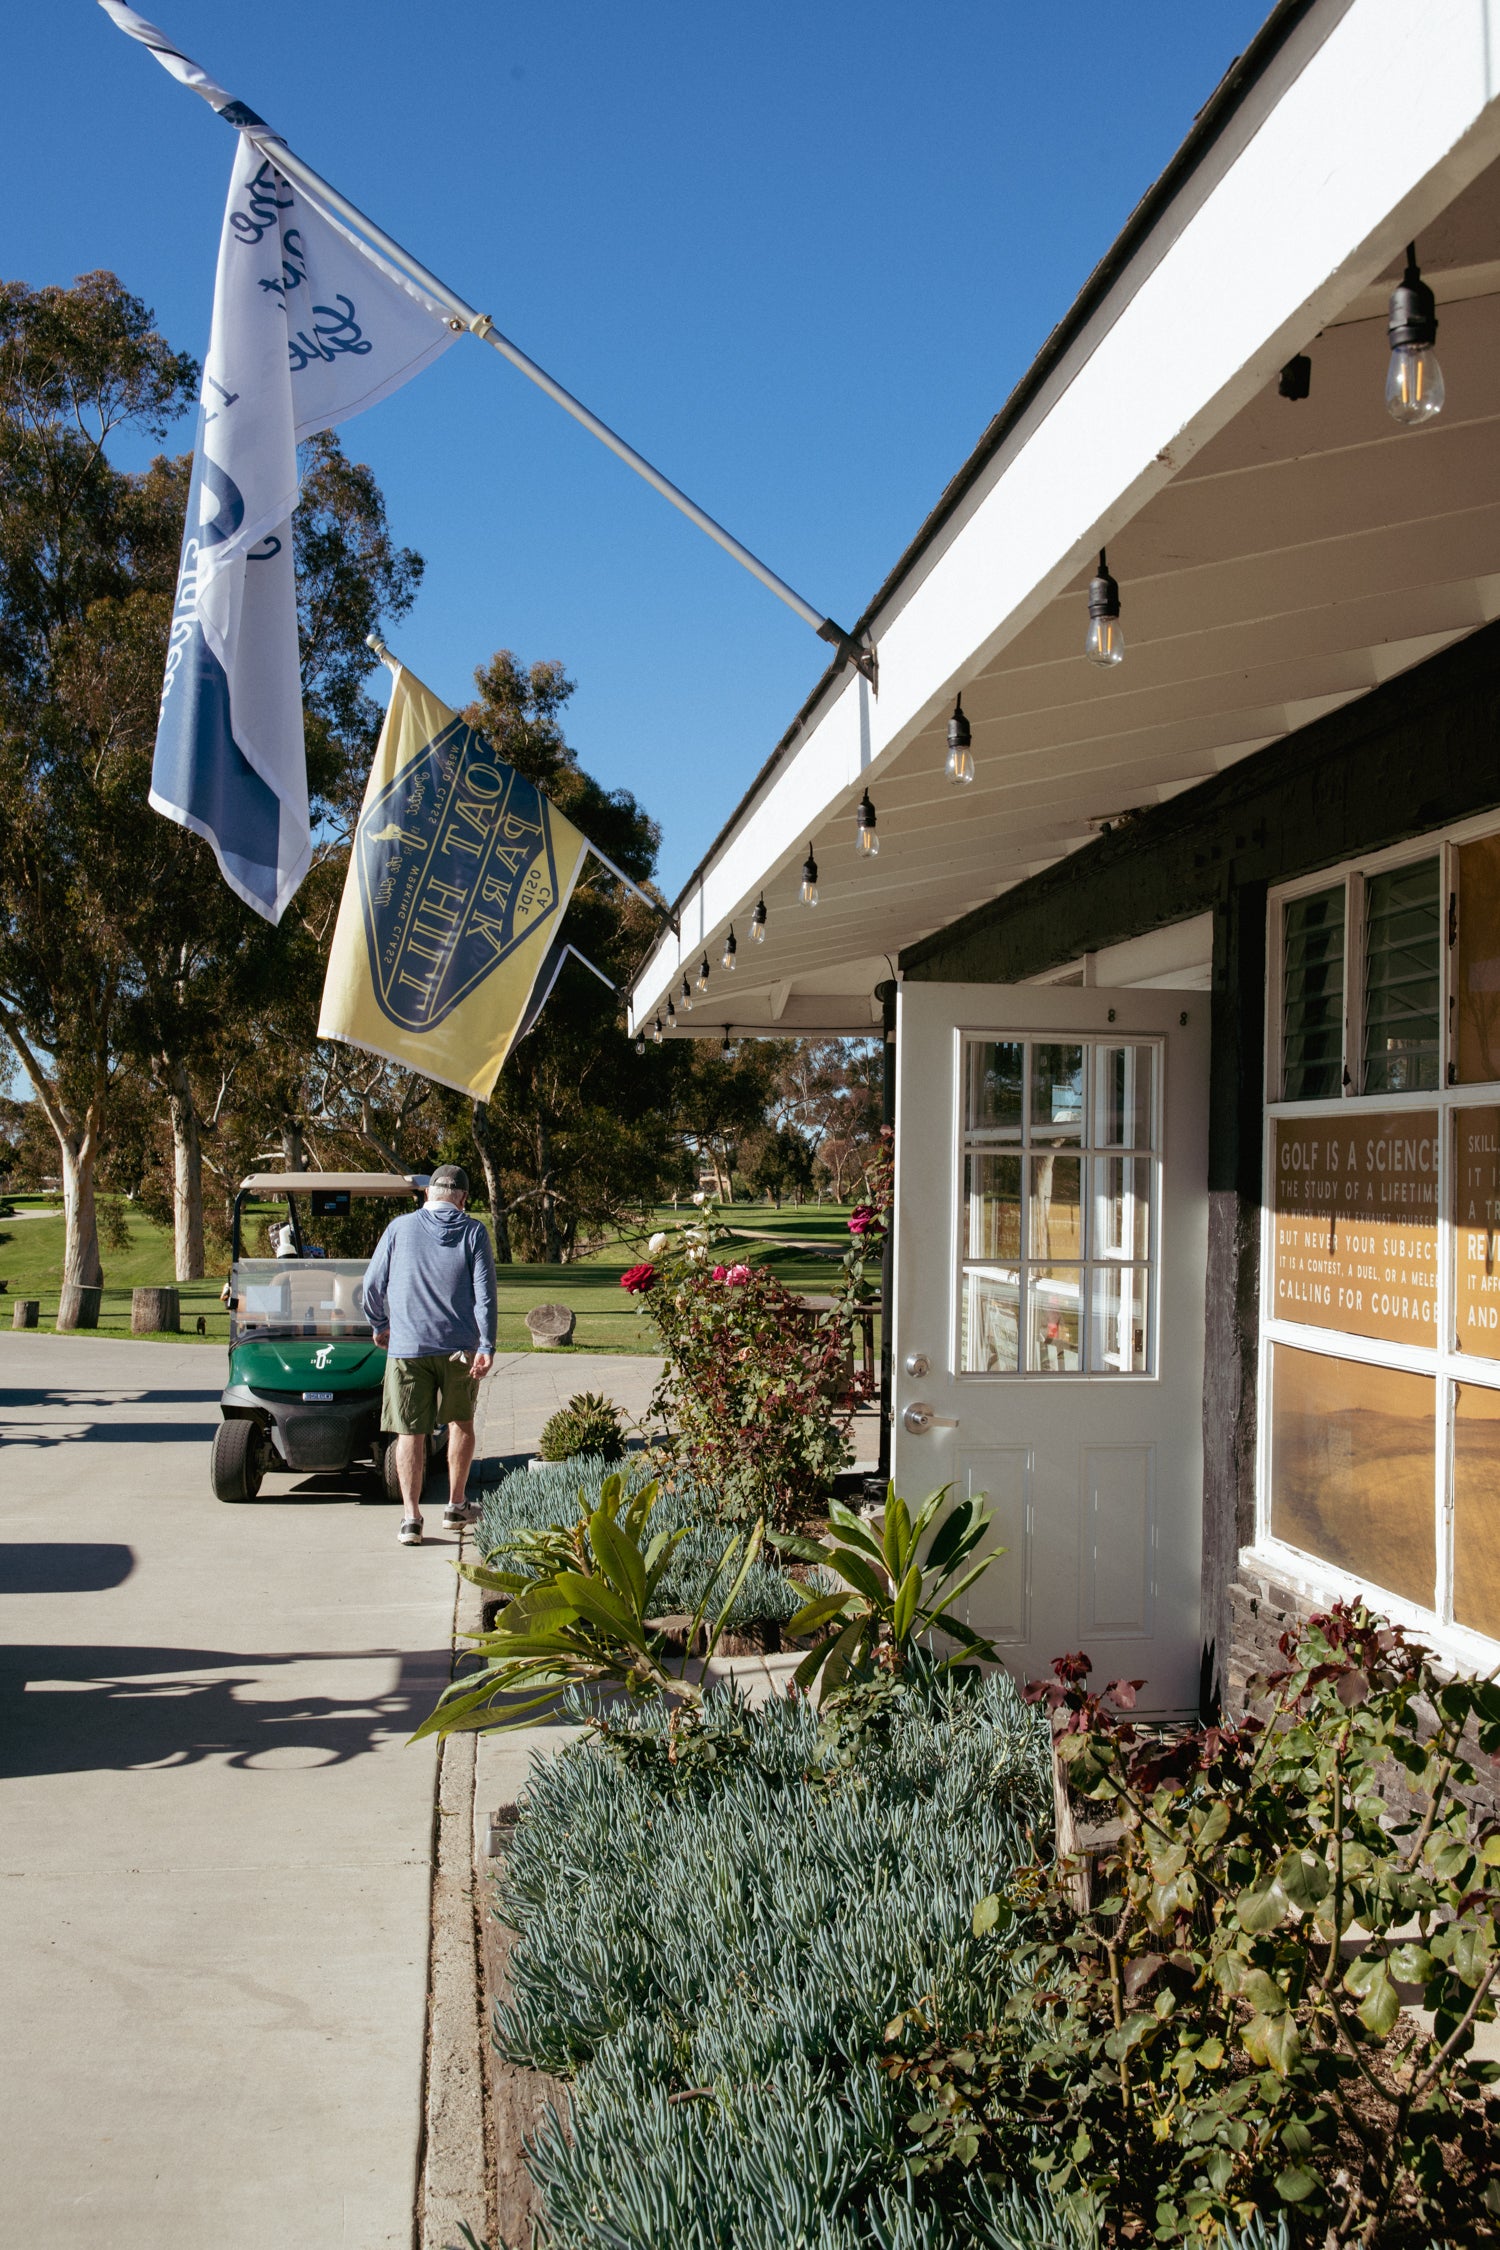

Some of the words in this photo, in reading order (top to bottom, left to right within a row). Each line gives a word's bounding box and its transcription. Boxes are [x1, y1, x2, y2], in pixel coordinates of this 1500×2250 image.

[1281, 1142, 1319, 1171] GOLF
[1326, 1140, 1339, 1171] IS
[1347, 1141, 1357, 1171] A
[1366, 1138, 1438, 1172] SCIENCE
[1468, 1167, 1481, 1187] IT
[1493, 1167, 1500, 1187] I
[1281, 1180, 1298, 1197] THE
[1304, 1180, 1338, 1199] STUDY
[1345, 1182, 1359, 1200] OF
[1367, 1183, 1374, 1200] A
[1381, 1183, 1438, 1203] LIFETIME
[1280, 1208, 1287, 1219] IN
[1291, 1208, 1313, 1220] WHICH
[1317, 1209, 1331, 1221] YOU
[1336, 1210, 1351, 1223] MAY
[1355, 1211, 1391, 1225] EXHAUST
[1468, 1200, 1476, 1220] A
[1280, 1229, 1298, 1246] BUT
[1304, 1232, 1338, 1250] NEVER
[1346, 1235, 1375, 1254] YOUR
[1280, 1255, 1286, 1268] IT
[1289, 1257, 1296, 1269] IS
[1299, 1258, 1304, 1270] A
[1307, 1258, 1344, 1277] CONTEST,
[1348, 1264, 1353, 1277] A
[1385, 1268, 1396, 1282] OR
[1400, 1270, 1407, 1284] A
[1468, 1274, 1476, 1290] IT
[1279, 1278, 1331, 1305] CALLING
[1339, 1287, 1363, 1310] FOR
[1371, 1292, 1438, 1324] COURAGE
[1468, 1305, 1498, 1329] AND
